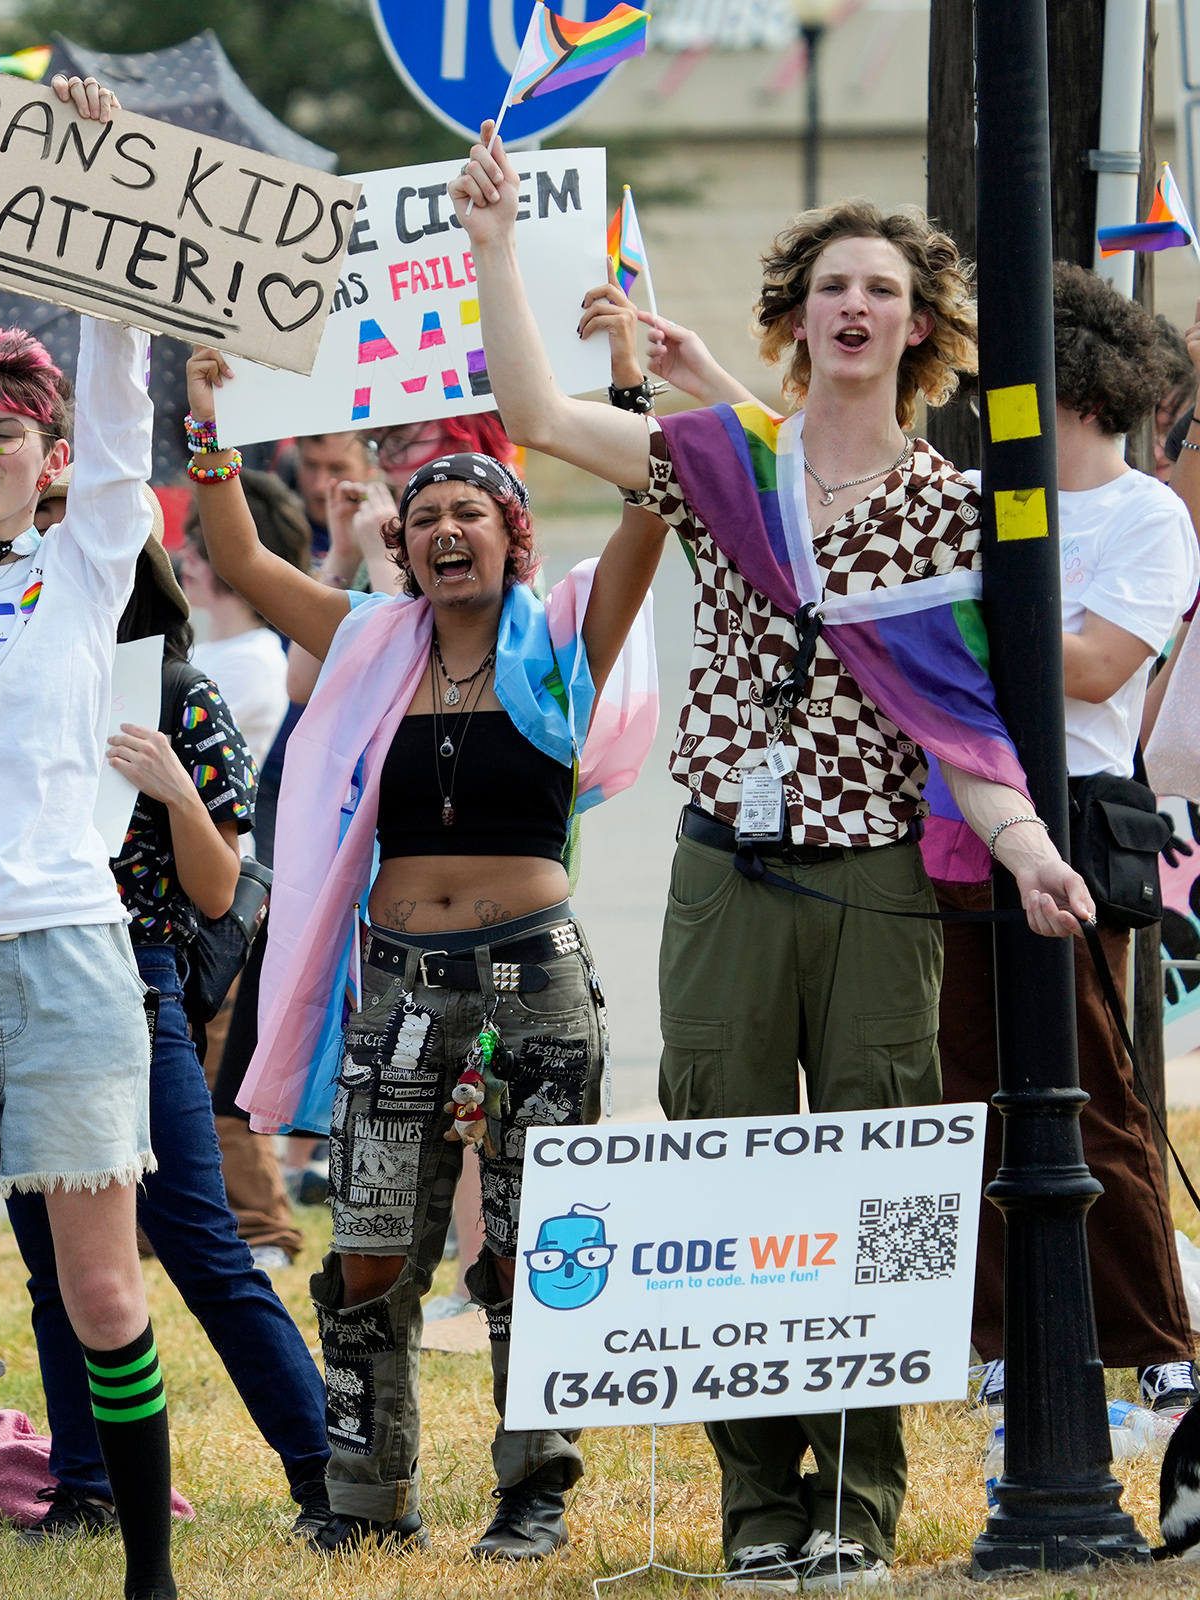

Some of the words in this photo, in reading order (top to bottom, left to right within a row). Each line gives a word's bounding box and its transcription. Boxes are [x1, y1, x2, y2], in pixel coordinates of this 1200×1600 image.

[178, 147, 354, 264] KIDS
[382, 1072, 409, 1080] EQUAL
[410, 1073, 437, 1082] RIGHTS
[379, 1100, 408, 1109] SPECIAL
[409, 1102, 434, 1110] RIGHTS
[354, 1118, 384, 1140] NAZI
[387, 1119, 424, 1142] LIVES
[532, 1129, 728, 1168] CODING
[745, 1124, 844, 1158] FOR
[861, 1114, 975, 1151] KIDS
[349, 1185, 379, 1205] DON'T
[380, 1189, 418, 1206] MATTER
[632, 1237, 739, 1276] CODE
[749, 1232, 839, 1270] WIZ
[646, 1278, 684, 1291] learn
[688, 1275, 702, 1288] to
[707, 1274, 746, 1288] code.
[750, 1272, 786, 1285] have
[790, 1269, 820, 1282] fun!
[604, 1325, 701, 1354] CALL
[711, 1321, 768, 1348] OR
[780, 1313, 877, 1344] TEXT
[543, 1365, 679, 1415] (346)
[691, 1359, 790, 1400] 483
[803, 1349, 932, 1393] 3736
